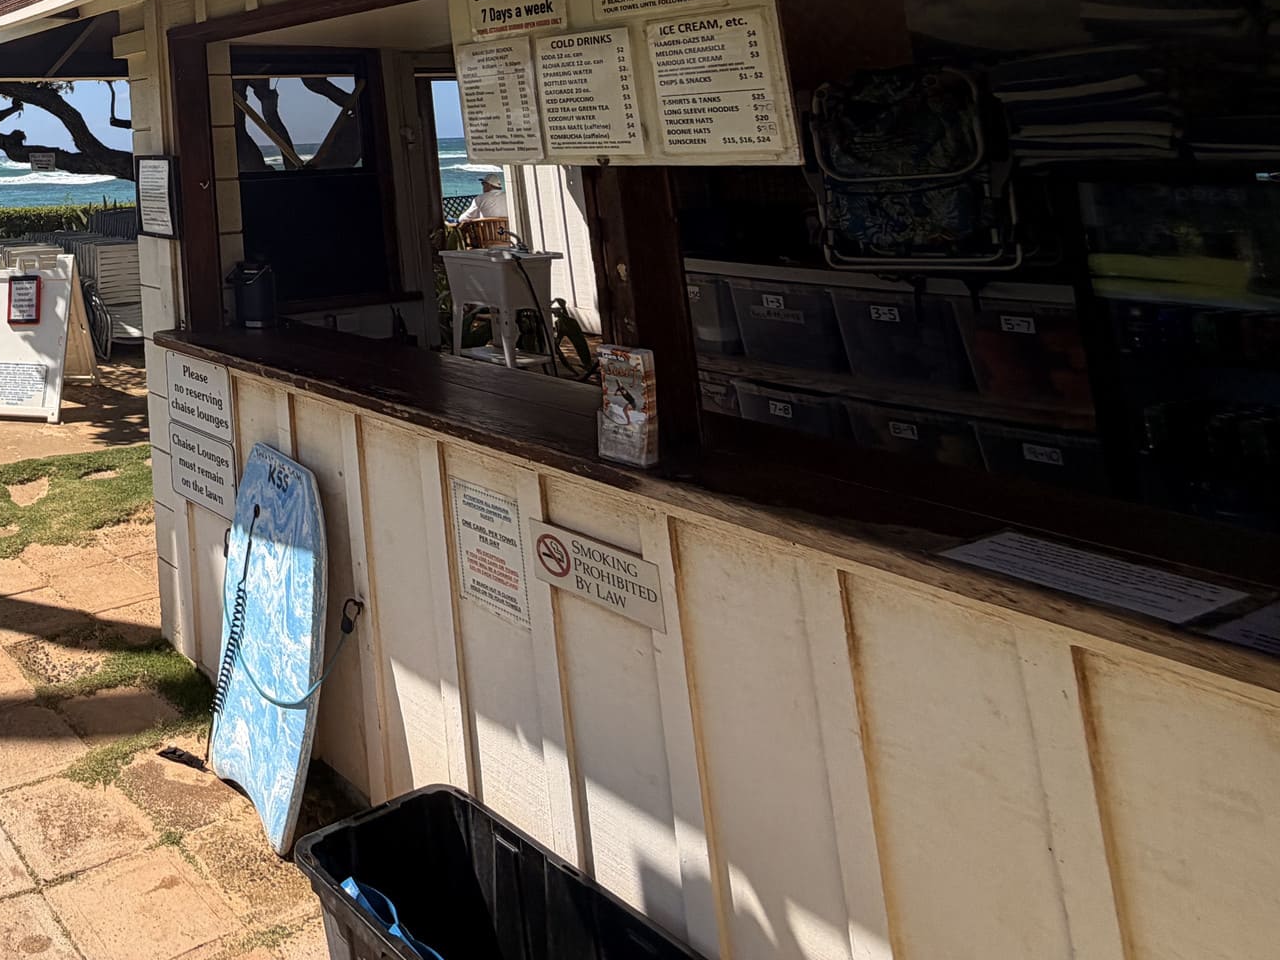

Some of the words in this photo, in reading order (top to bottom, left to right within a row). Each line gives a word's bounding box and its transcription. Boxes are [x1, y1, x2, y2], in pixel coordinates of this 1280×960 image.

[482, 9, 486, 23] 7
[490, 8, 512, 23] Days
[515, 7, 521, 17] a
[524, 0, 553, 16] week
[660, 25, 675, 36] ICE
[678, 19, 723, 34] CREAM,
[726, 17, 747, 27] etc.
[551, 39, 574, 49] COLD
[577, 34, 612, 46] DRINKS
[656, 48, 683, 57] MELONA
[684, 44, 725, 54] CREAMSICLE
[657, 59, 685, 67] VARIOUS
[662, 97, 690, 105] T-SHIRTS
[683, 106, 706, 114] SLEEVE
[707, 105, 739, 113] HOODIES
[755, 114, 769, 122] $20
[872, 307, 896, 320] 3-5
[183, 365, 208, 384] Please
[175, 383, 184, 394] no
[186, 388, 222, 410] reserving
[172, 398, 195, 416] chaise
[197, 406, 229, 429] lounges
[172, 434, 195, 452] Chaise
[198, 444, 229, 468] Lounges
[179, 458, 196, 472] must
[198, 466, 224, 486] remain
[268, 464, 289, 493] KSS
[182, 477, 191, 488] on
[192, 480, 204, 494] the
[206, 486, 224, 505] lawn
[462, 519, 472, 527] ONE
[488, 530, 498, 538] PER
[479, 535, 488, 543] PER
[571, 540, 638, 578] SMOKING
[574, 558, 657, 604] PROHIBITED
[576, 575, 591, 594] BY
[596, 583, 626, 608] LAW
